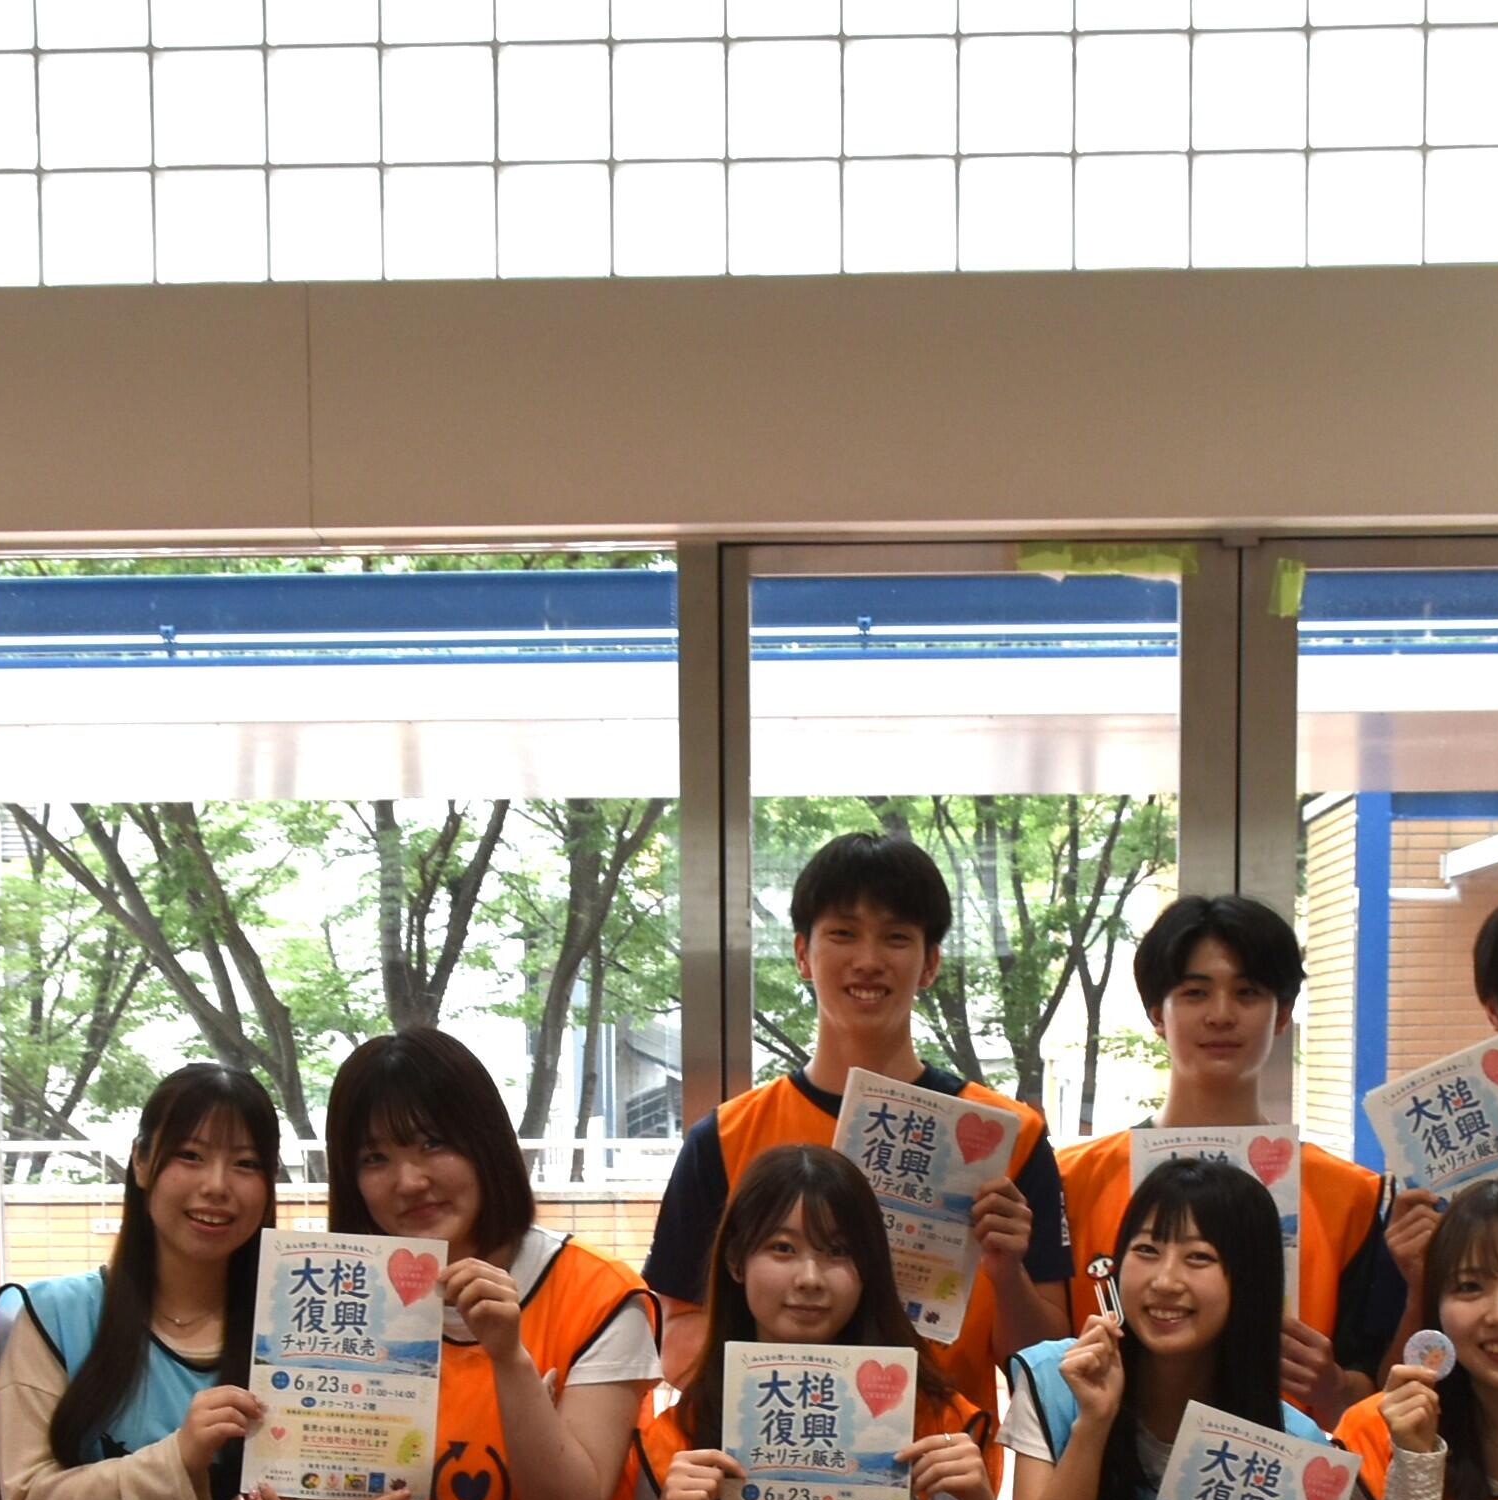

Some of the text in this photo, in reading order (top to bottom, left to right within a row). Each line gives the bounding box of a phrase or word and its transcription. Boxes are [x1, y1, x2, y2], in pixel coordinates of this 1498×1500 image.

[1406, 1077, 1480, 1133] 大槌
[863, 1102, 936, 1152] 大槌
[1421, 1109, 1490, 1159] 復興
[861, 1137, 931, 1183] 復興
[867, 1175, 934, 1205] リティ販売
[289, 1257, 370, 1299] 大槌
[292, 1297, 367, 1336] 復興
[280, 1334, 376, 1356] チャリティ販売
[756, 1370, 839, 1411] 大槌
[759, 1409, 838, 1448] 復興
[750, 1447, 846, 1468] チャリティ販売
[1200, 1440, 1282, 1498] 大槌
